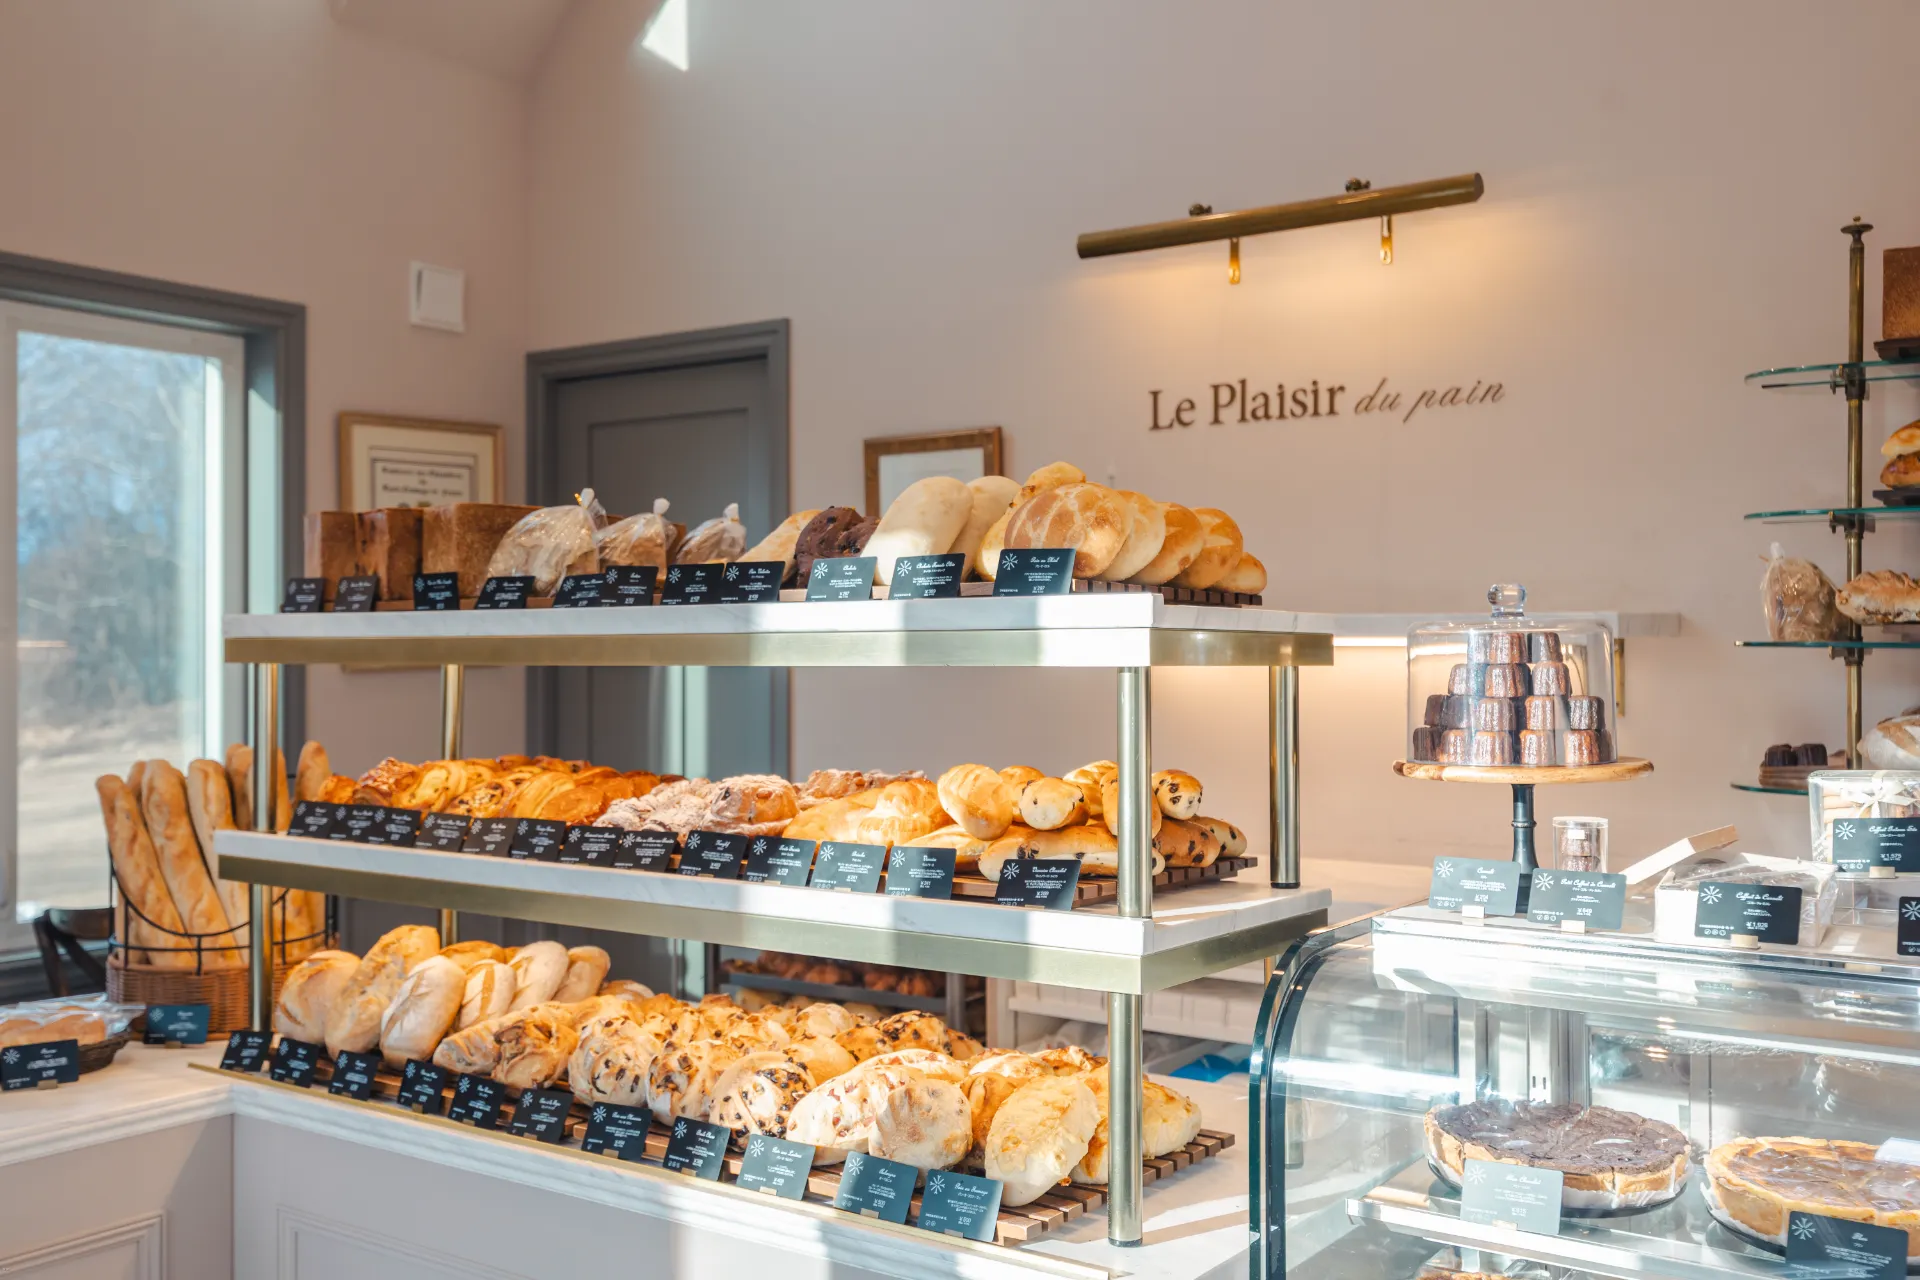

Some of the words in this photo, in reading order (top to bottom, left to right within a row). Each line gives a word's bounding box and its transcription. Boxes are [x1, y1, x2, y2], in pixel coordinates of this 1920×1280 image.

[1148, 389, 1197, 431] Le
[1208, 378, 1347, 426] Plaisir
[1353, 377, 1402, 415] du
[1402, 379, 1506, 424] pain
